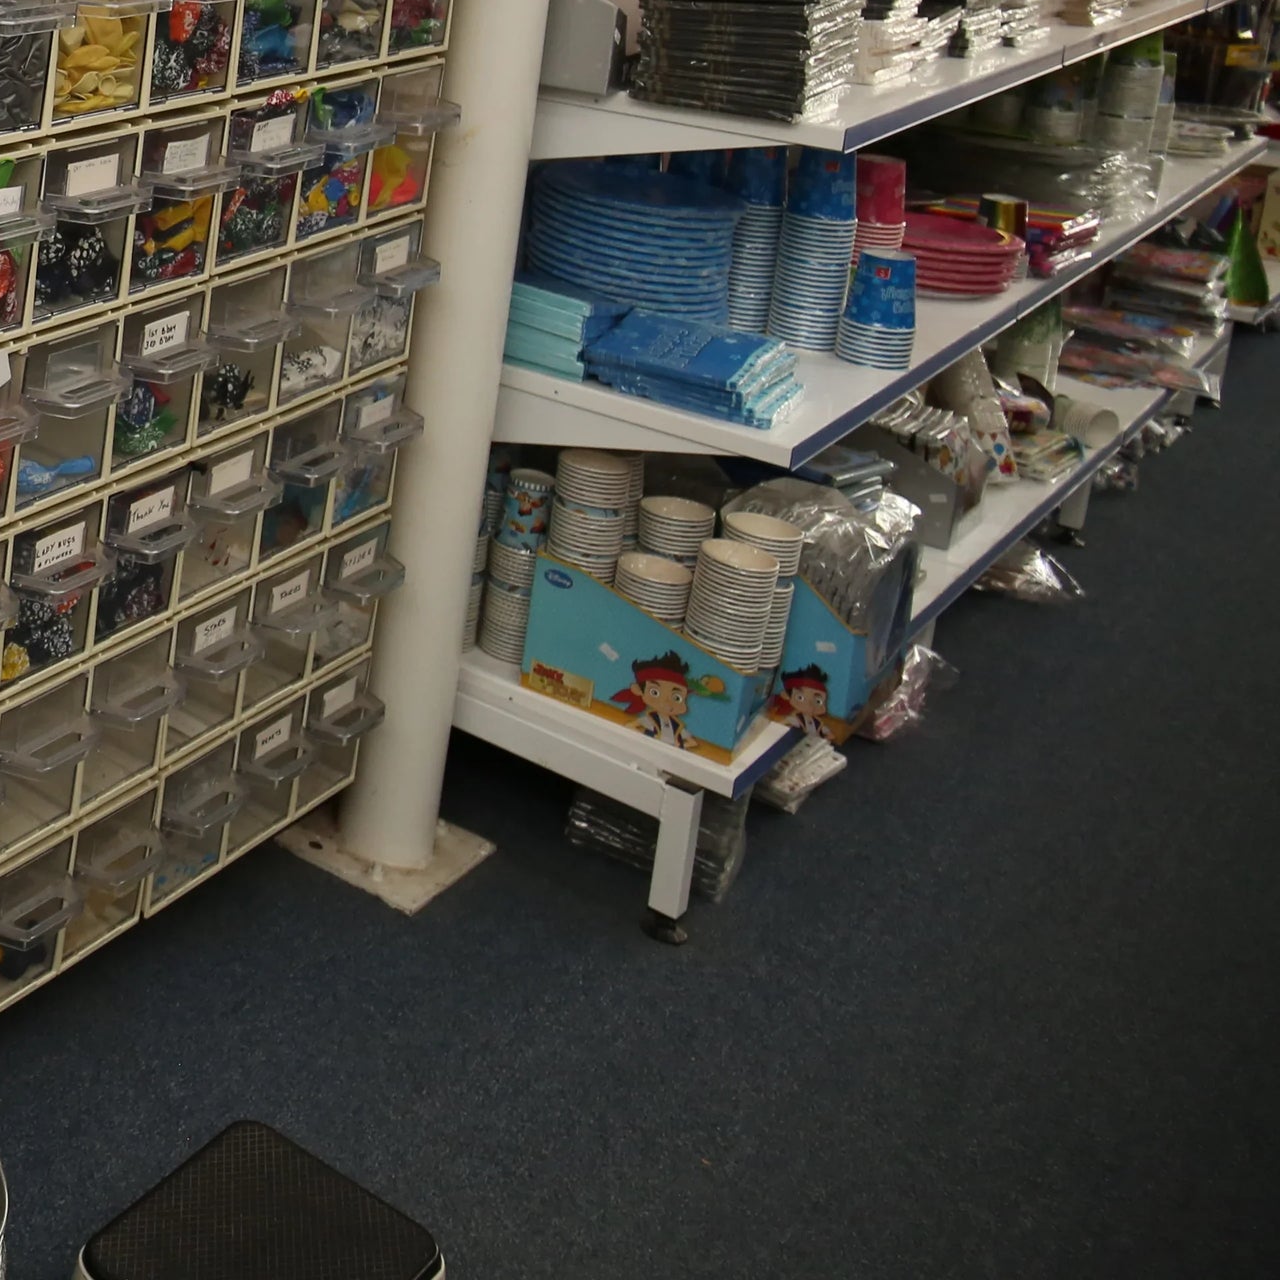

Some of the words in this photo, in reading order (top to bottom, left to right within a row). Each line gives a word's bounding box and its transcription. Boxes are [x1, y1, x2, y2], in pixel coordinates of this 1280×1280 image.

[132, 504, 155, 522] Thank
[36, 543, 54, 559] LADY
[57, 536, 76, 551] BUGS
